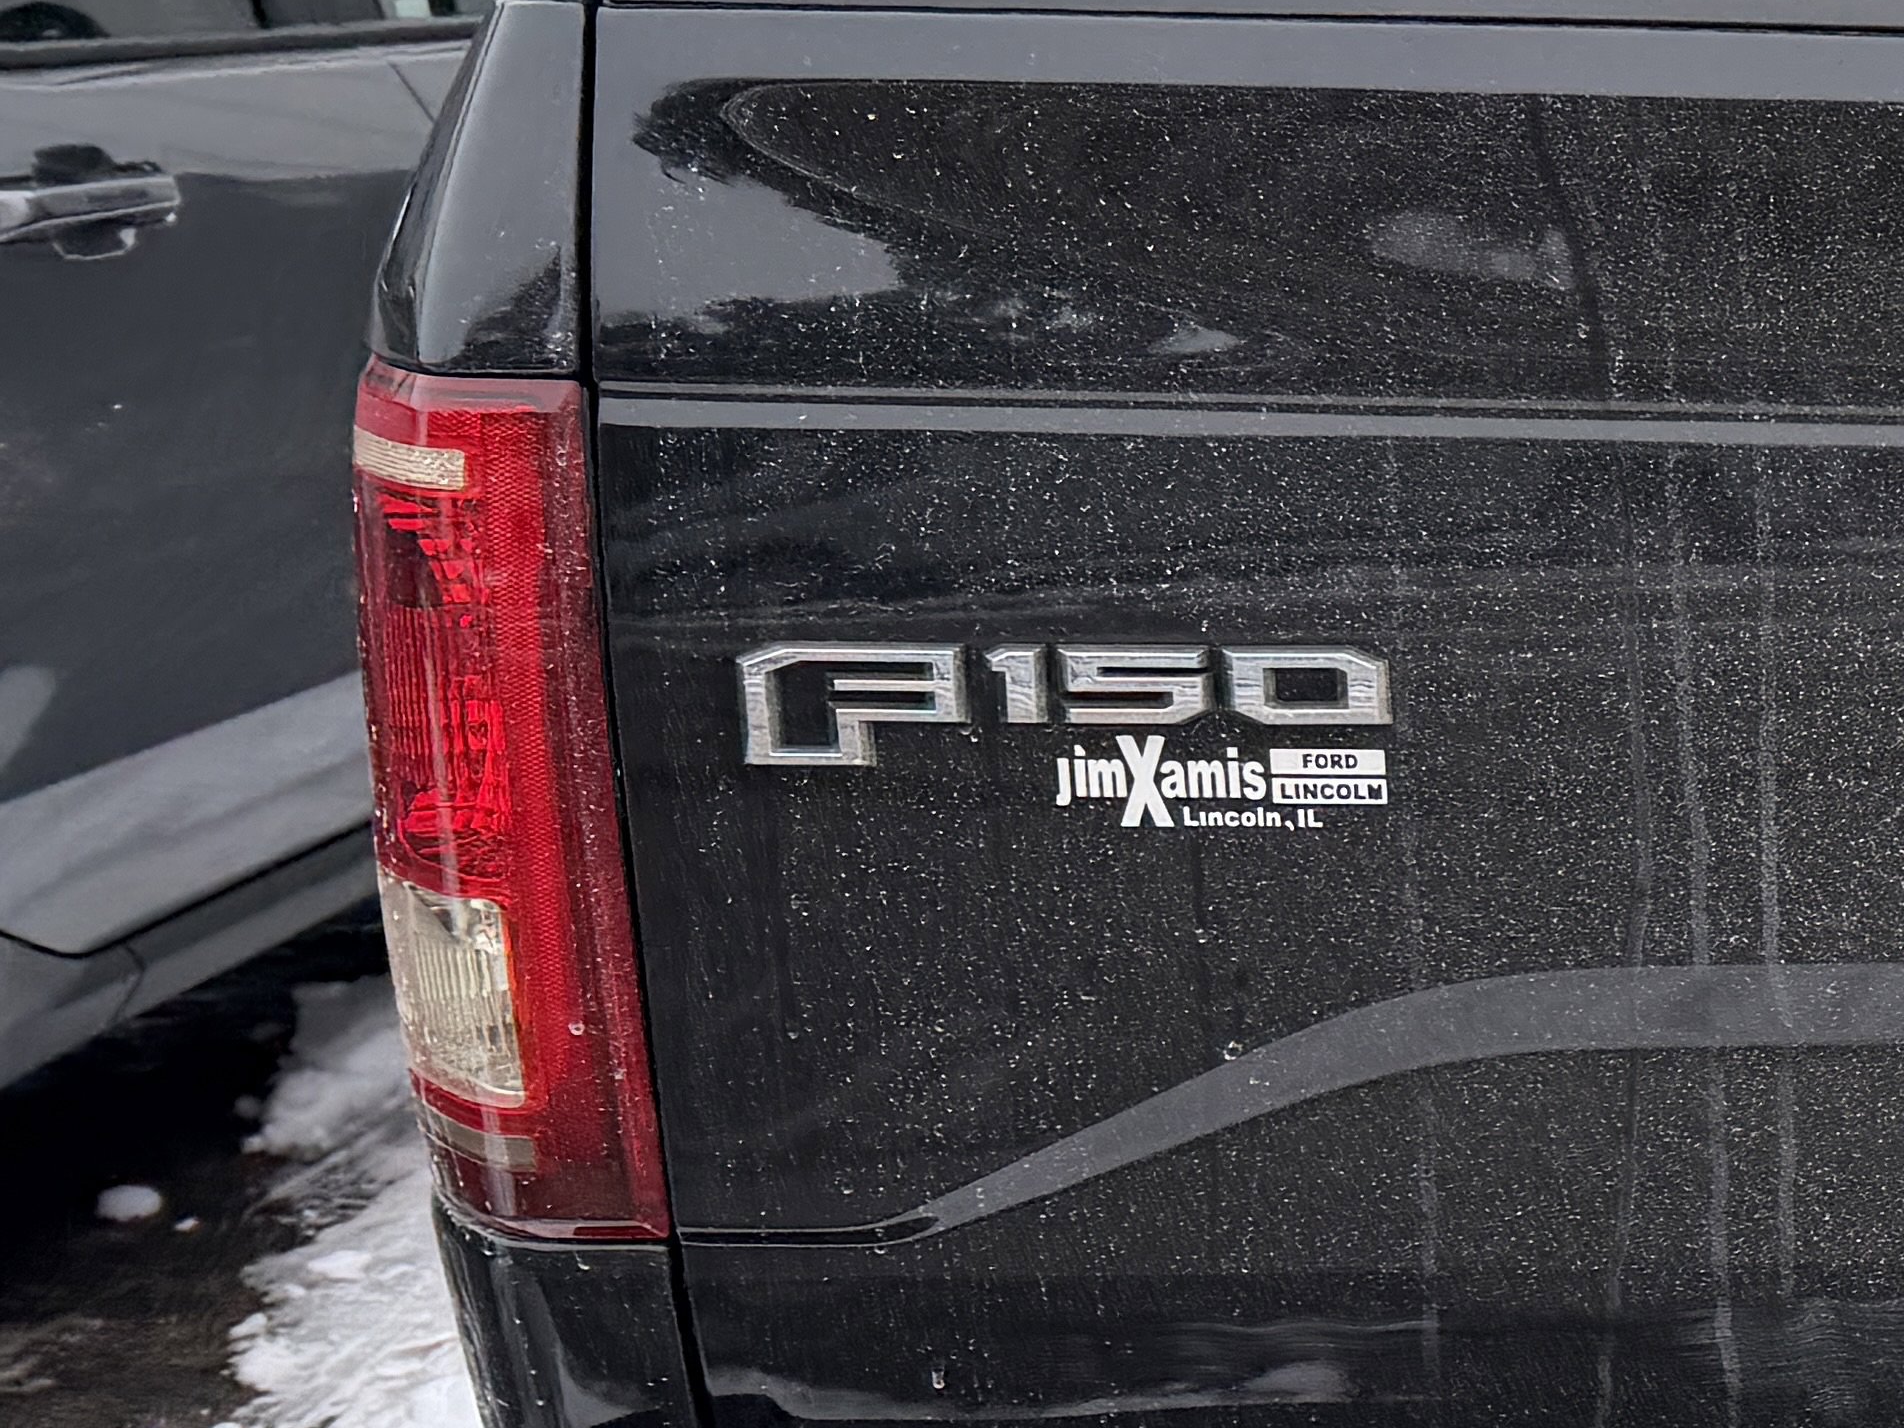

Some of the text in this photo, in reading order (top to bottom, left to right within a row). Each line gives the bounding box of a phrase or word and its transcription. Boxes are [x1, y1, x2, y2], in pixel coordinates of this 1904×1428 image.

[1302, 753, 1359, 770] FORD
[1279, 783, 1383, 801] LINCOLN
[1297, 809, 1323, 828] IL
